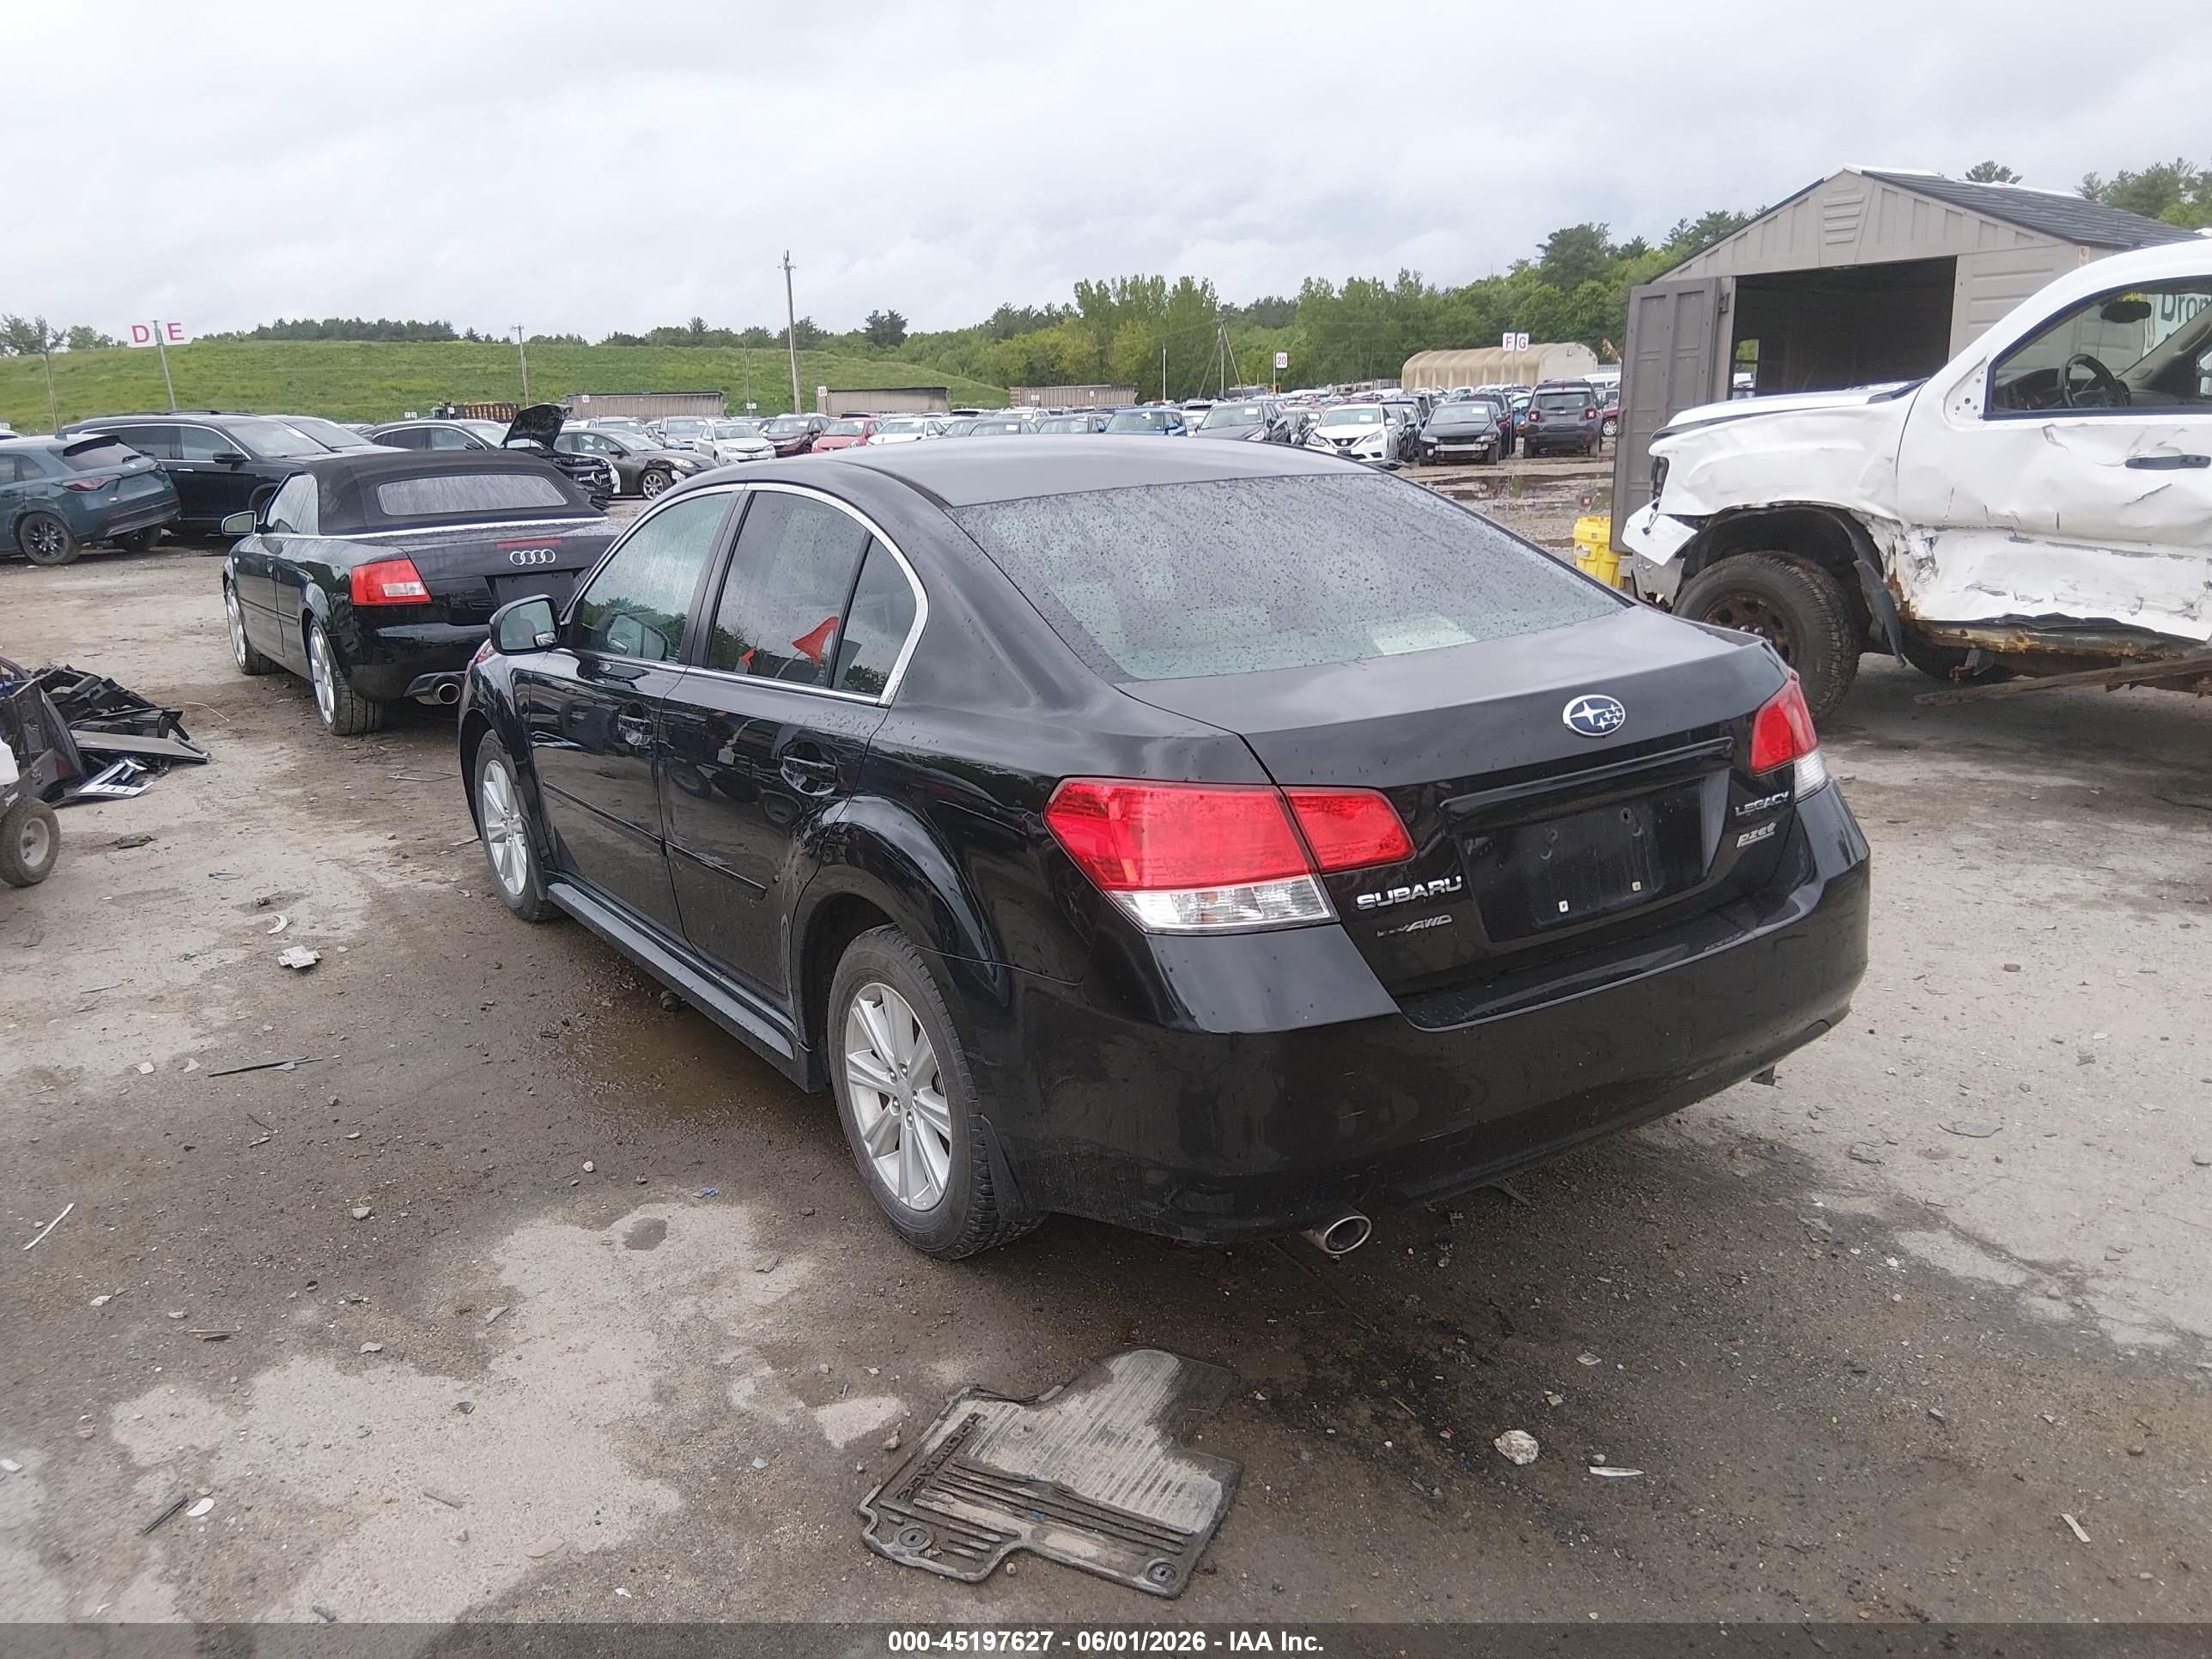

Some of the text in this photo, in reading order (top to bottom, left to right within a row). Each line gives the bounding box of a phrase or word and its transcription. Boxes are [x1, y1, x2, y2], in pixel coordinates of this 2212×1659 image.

[131, 325, 150, 343] D
[167, 322, 185, 341] E
[1505, 336, 1512, 349] F
[1518, 336, 1527, 349] G
[1277, 356, 1286, 365] 20
[1735, 790, 1790, 817] LEGACY
[1357, 875, 1462, 910] SUBARU
[1406, 915, 1453, 933] AWD
